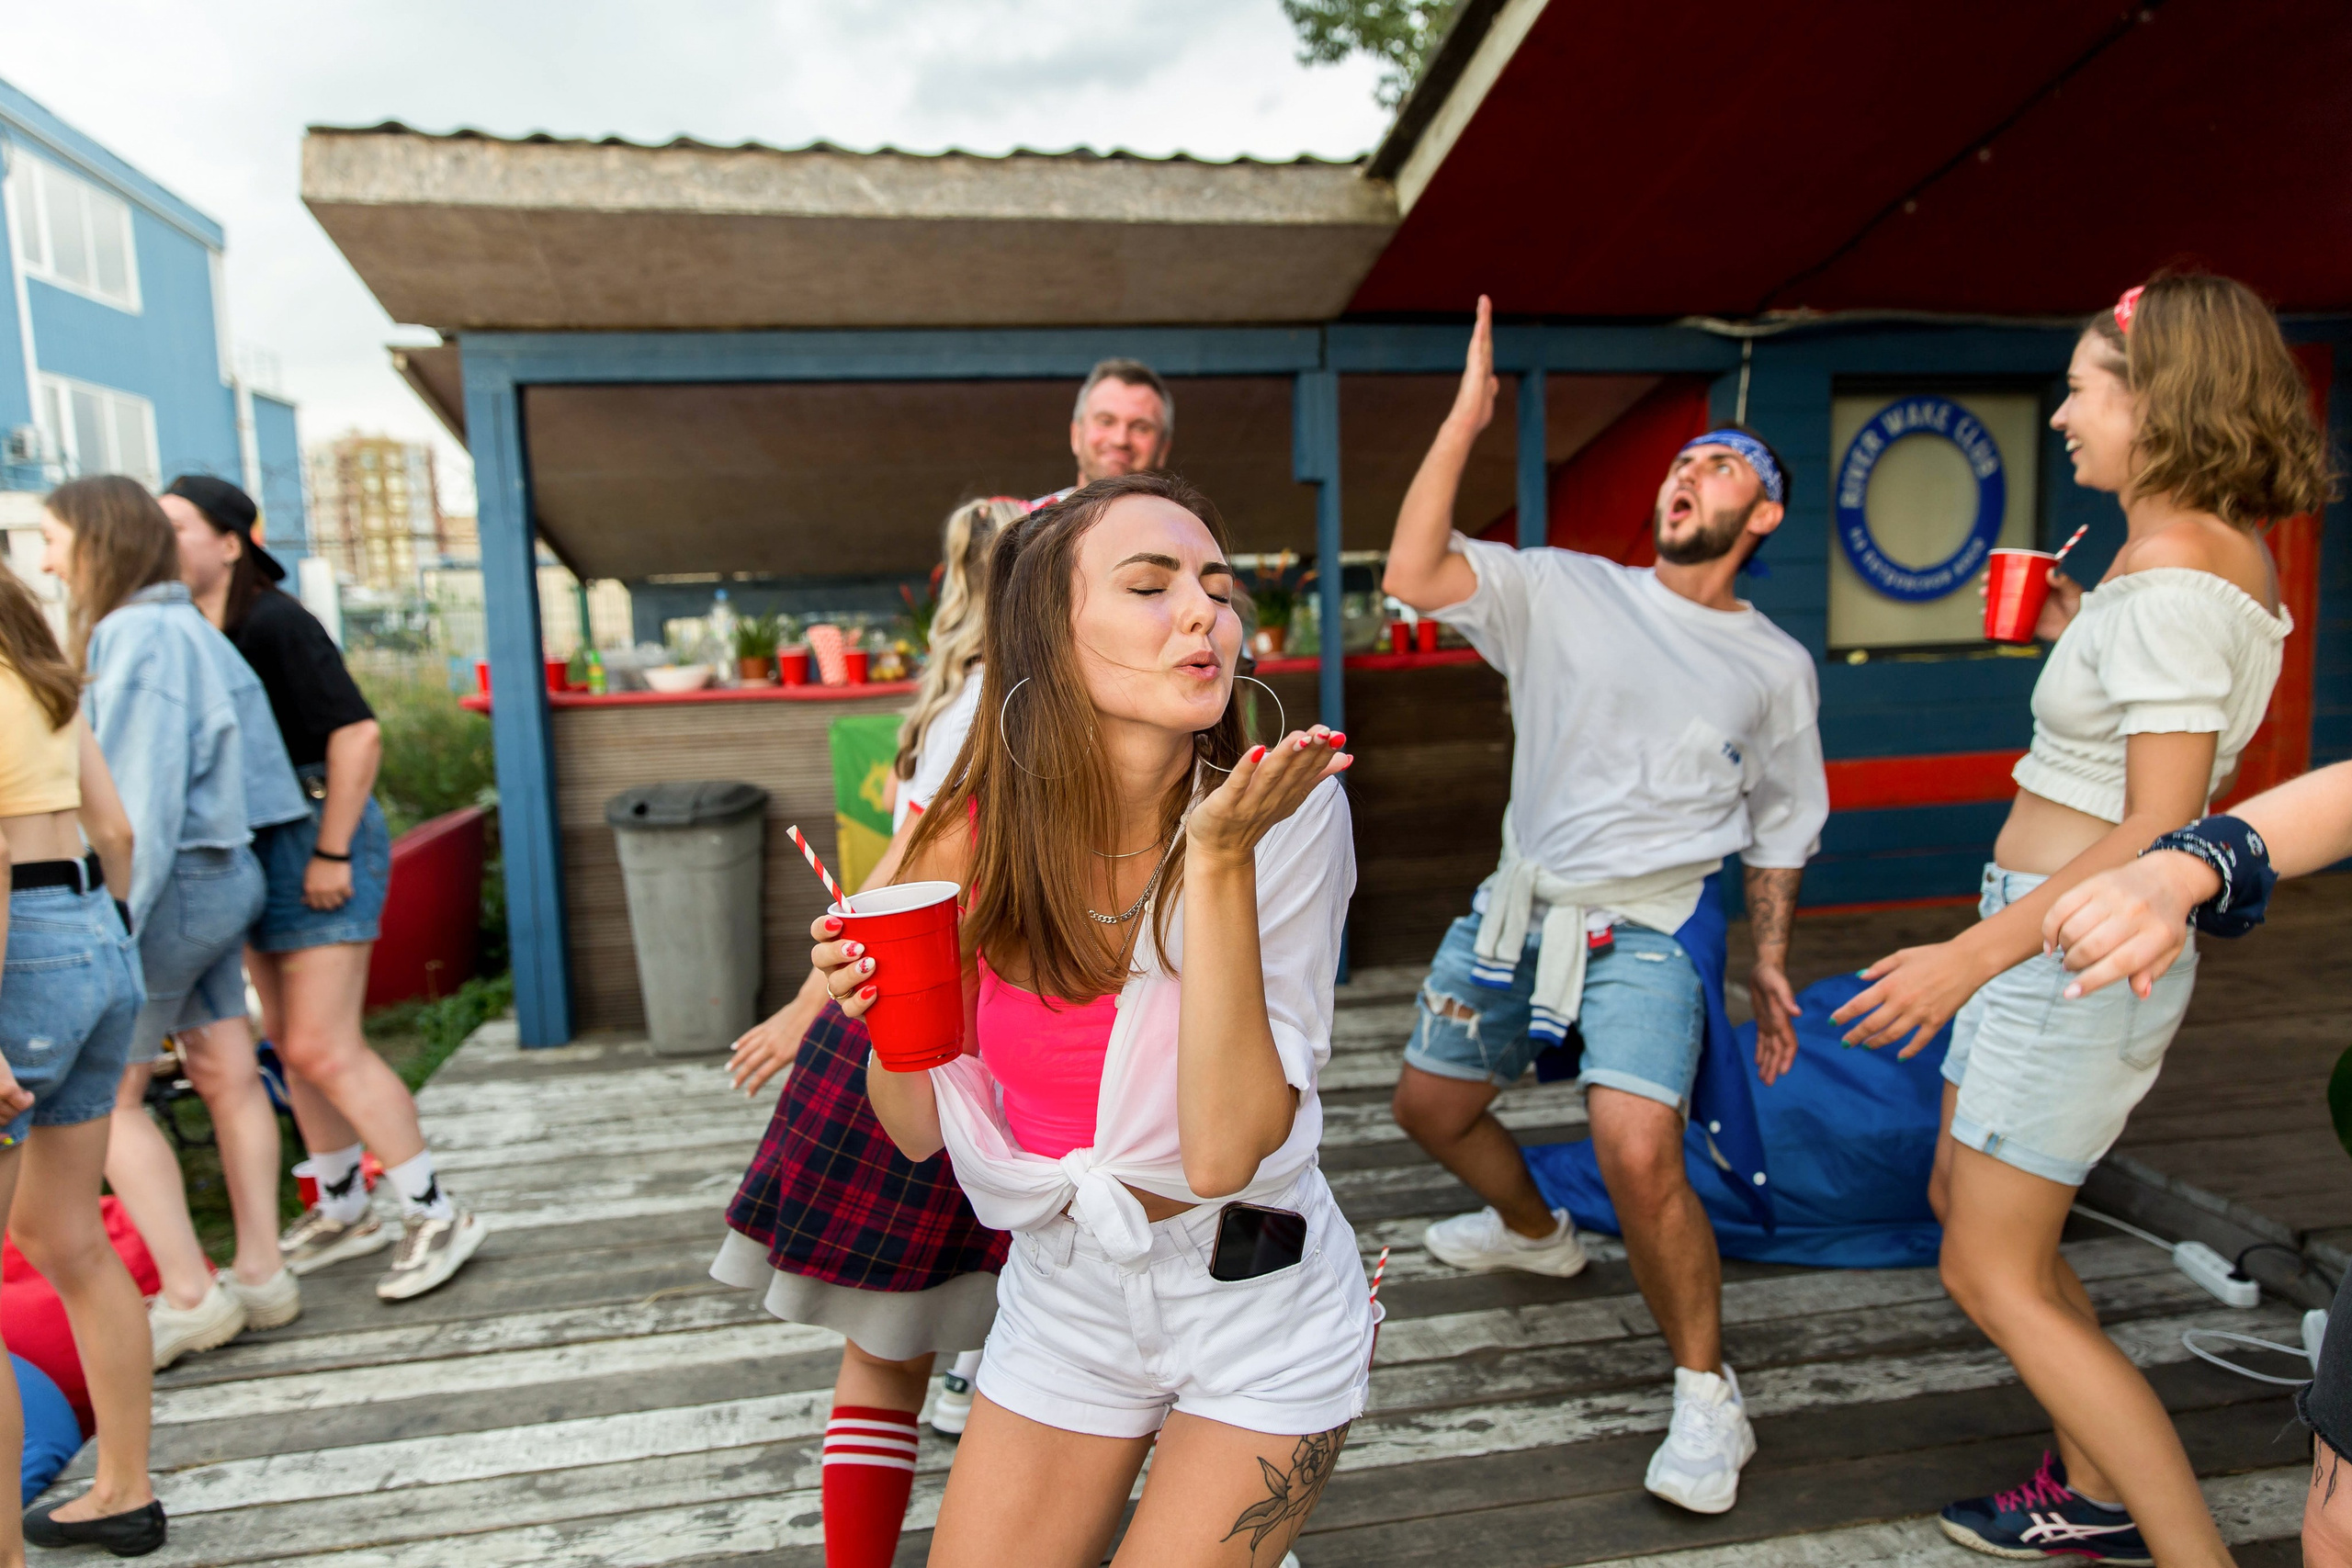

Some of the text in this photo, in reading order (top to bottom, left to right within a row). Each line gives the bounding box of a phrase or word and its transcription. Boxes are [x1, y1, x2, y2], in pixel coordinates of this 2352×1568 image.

[1839, 401, 1999, 508] RIVER WAKE CLUB
